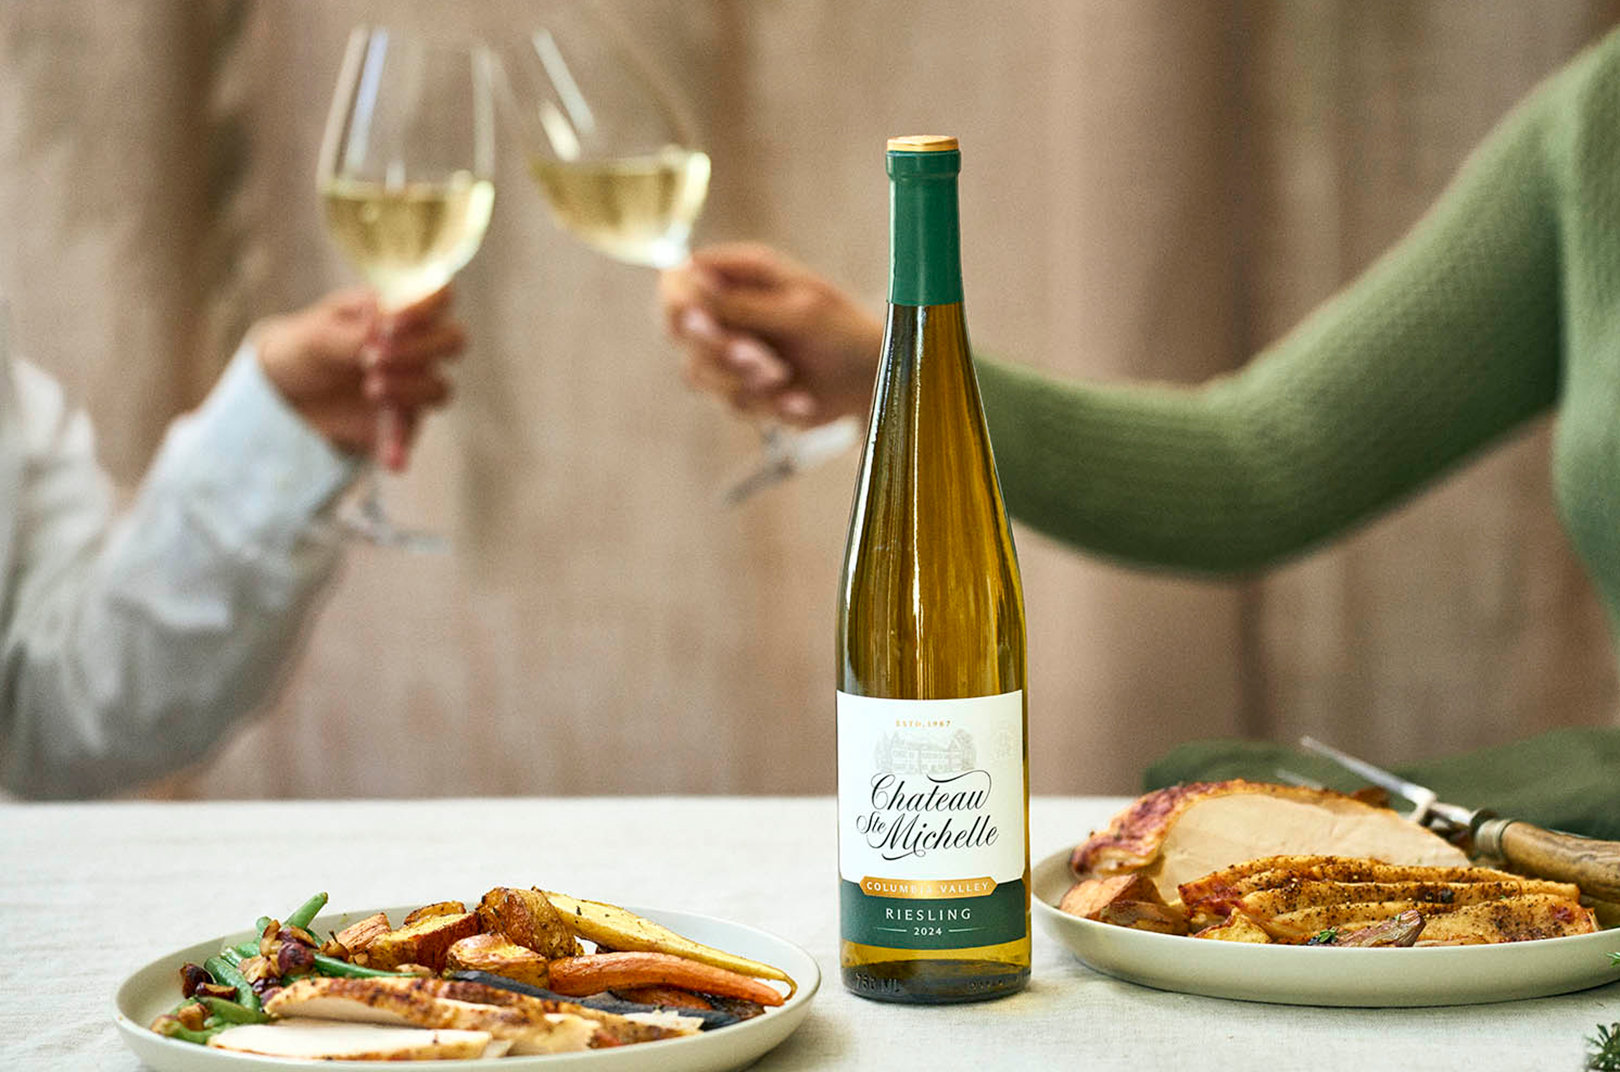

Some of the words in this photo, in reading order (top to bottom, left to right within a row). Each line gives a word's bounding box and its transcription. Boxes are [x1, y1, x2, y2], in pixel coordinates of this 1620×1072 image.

[870, 769, 992, 812] Chateau
[856, 810, 887, 834] Ste
[866, 813, 1000, 861] Michelle
[866, 881, 932, 894] COLUMBIA
[940, 882, 990, 893] VALLEY
[885, 908, 971, 921] RIESLING
[913, 926, 943, 936] 2024
